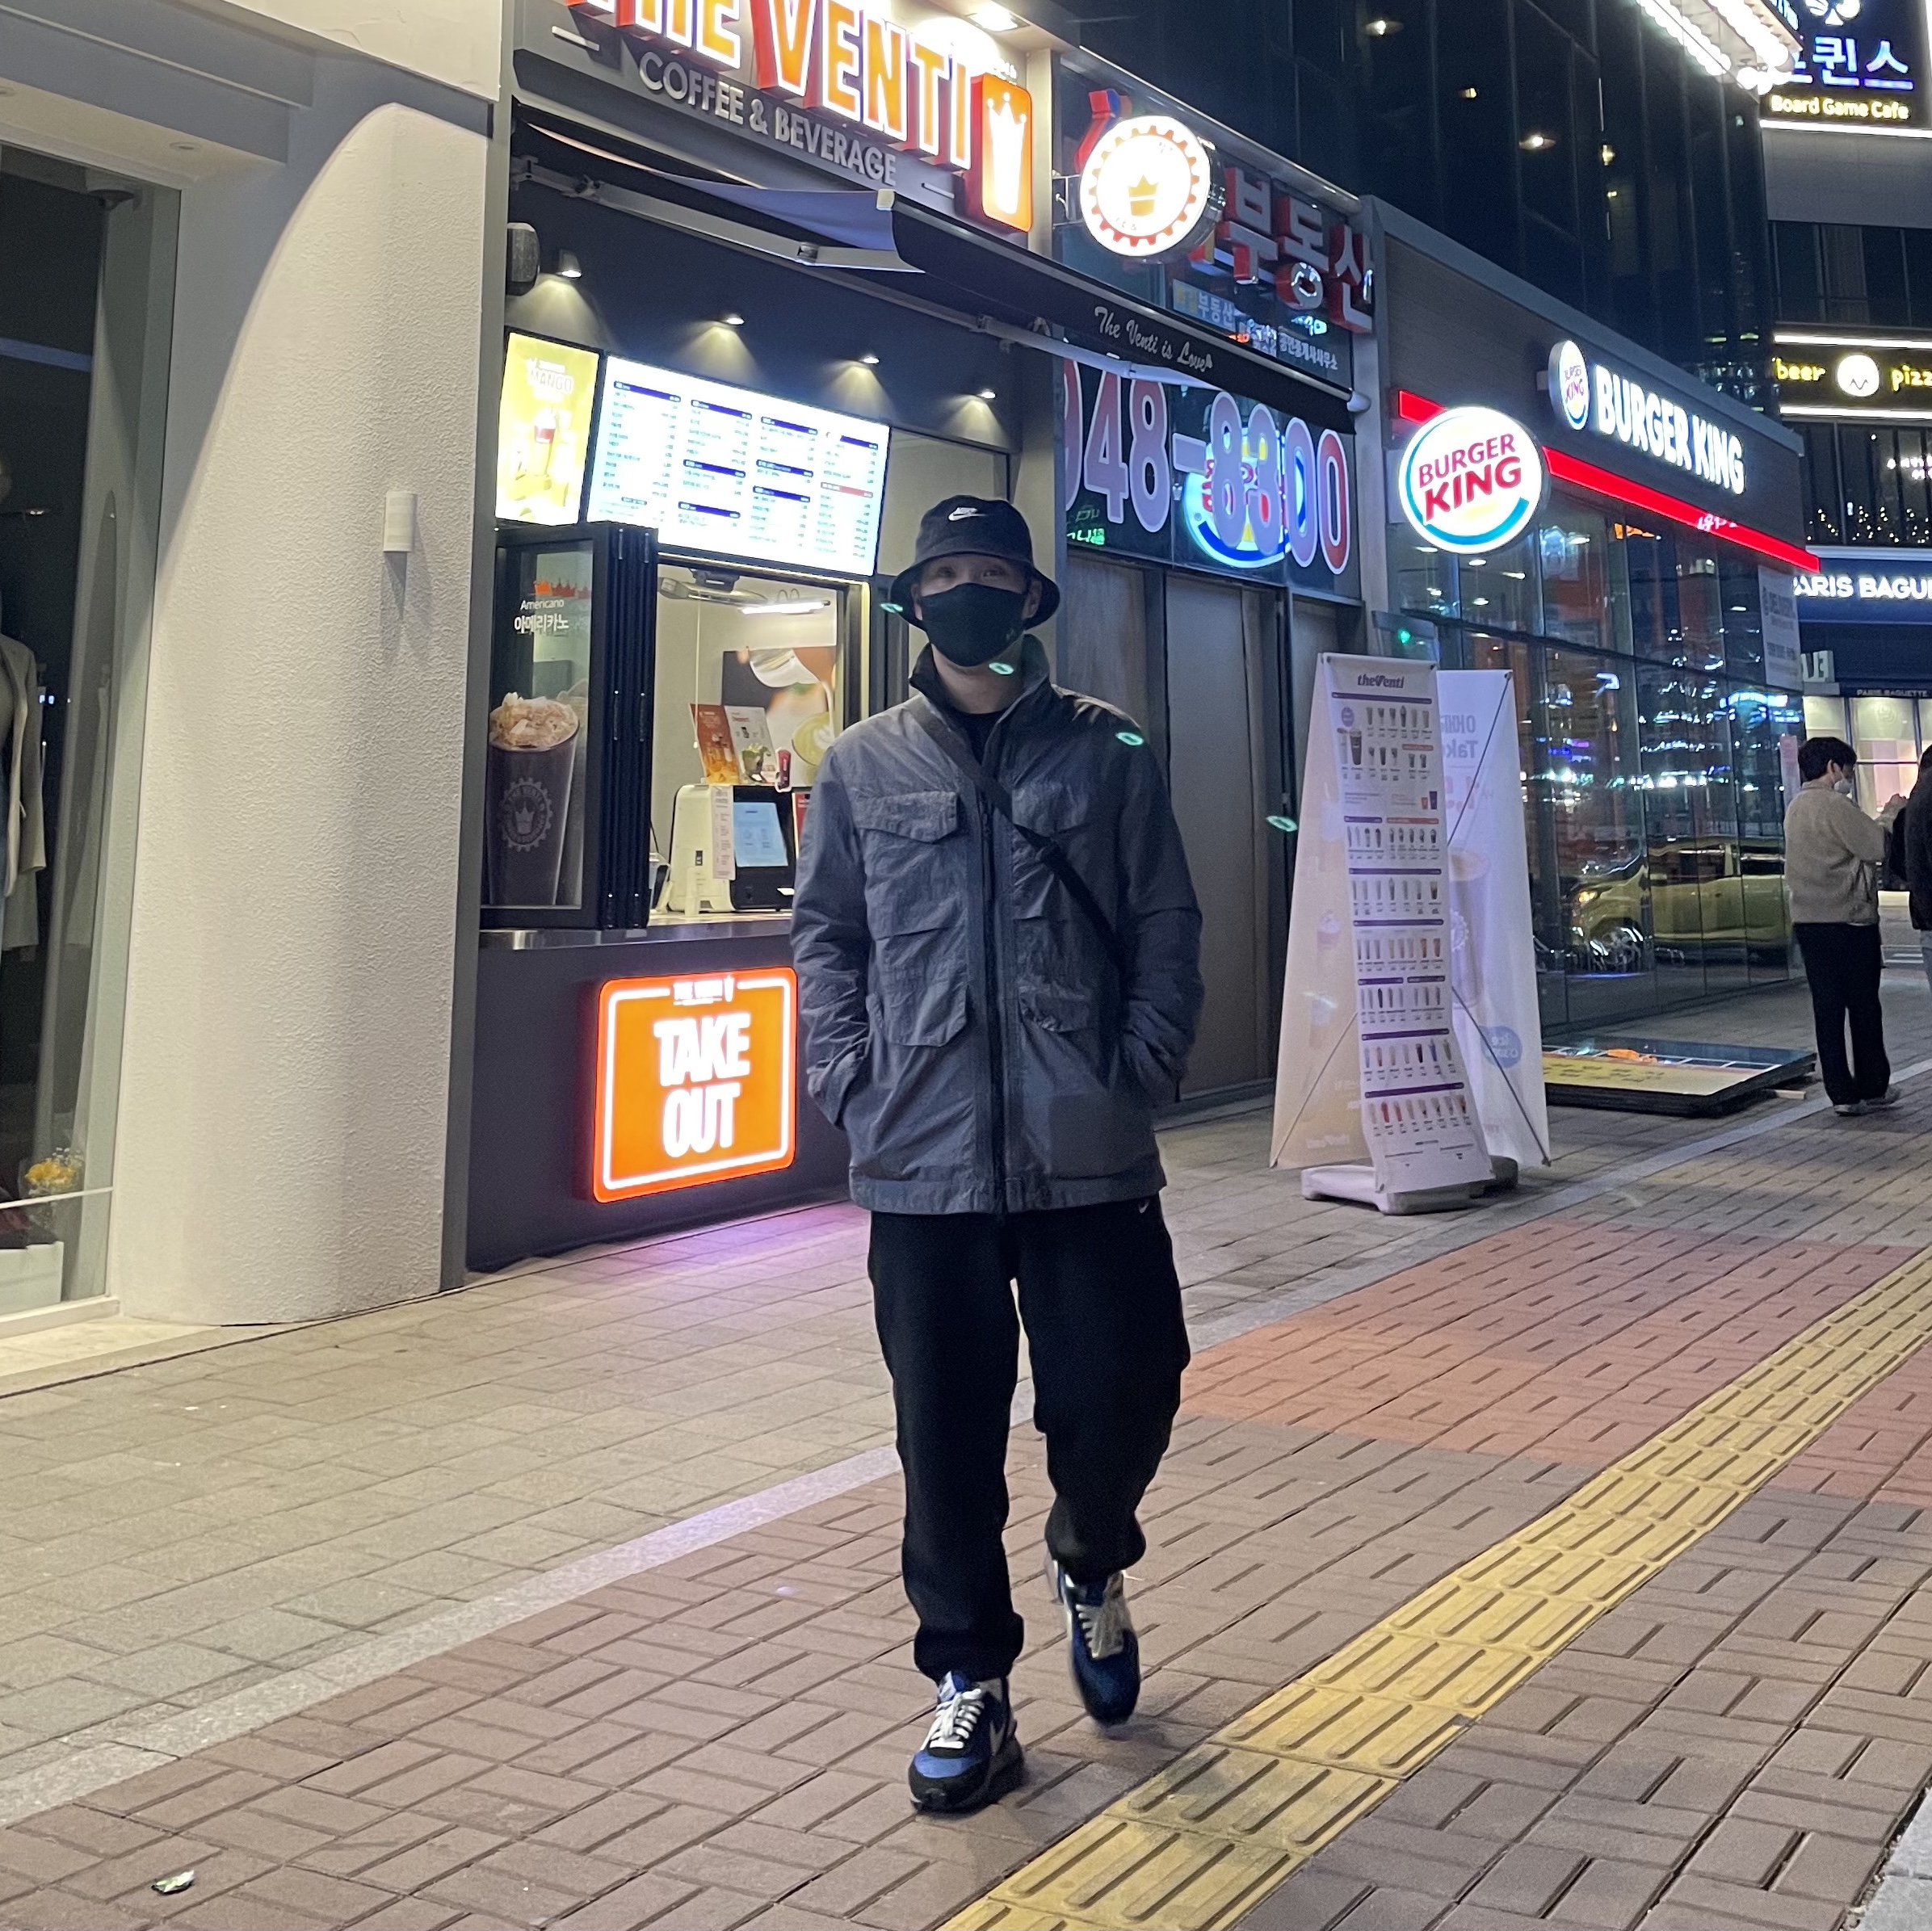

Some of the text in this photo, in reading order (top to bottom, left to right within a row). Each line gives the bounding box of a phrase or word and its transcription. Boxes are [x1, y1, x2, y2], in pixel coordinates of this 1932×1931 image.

[768, 0, 971, 170] VENTI
[1771, 95, 1909, 120] Board Game Cafe
[639, 51, 896, 187] COFFEE & BEVERAGE
[1094, 306, 1121, 338] The
[1126, 319, 1158, 354] Venti
[1161, 340, 1173, 359] is
[1776, 357, 1826, 381] beer
[1594, 363, 1746, 495] BURGER KING
[1418, 434, 1515, 488] BURGER
[1424, 455, 1522, 522] KING
[520, 599, 565, 611] Americano
[1793, 575, 1854, 598] ARIS
[514, 613, 569, 634] 아메리카노
[653, 1012, 751, 1087] TAKE
[662, 1081, 741, 1158] OUT
